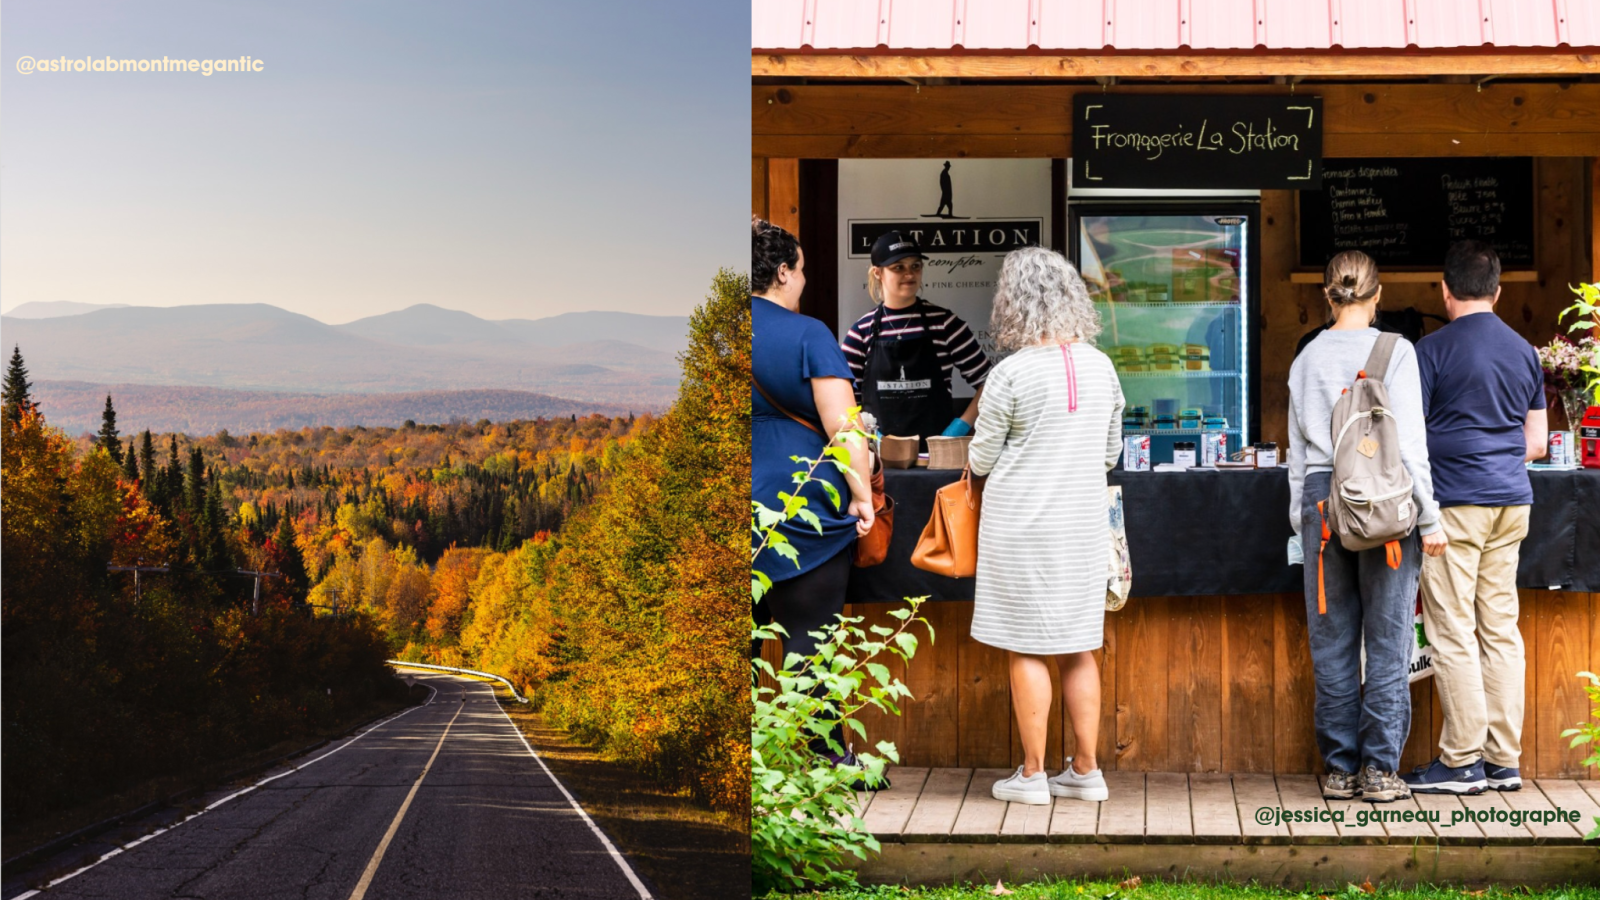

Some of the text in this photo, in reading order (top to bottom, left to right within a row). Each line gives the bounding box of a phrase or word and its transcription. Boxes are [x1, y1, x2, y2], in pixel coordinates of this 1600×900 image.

[1091, 117, 1299, 160] Fromagerie La Station
[892, 227, 1030, 247] TATION
[1399, 230, 1408, 245] 2
[928, 254, 986, 274] compton
[932, 281, 954, 289] FINE
[955, 280, 991, 288] CHEESE
[887, 381, 929, 389] STATION
[1408, 654, 1431, 675] ulk
